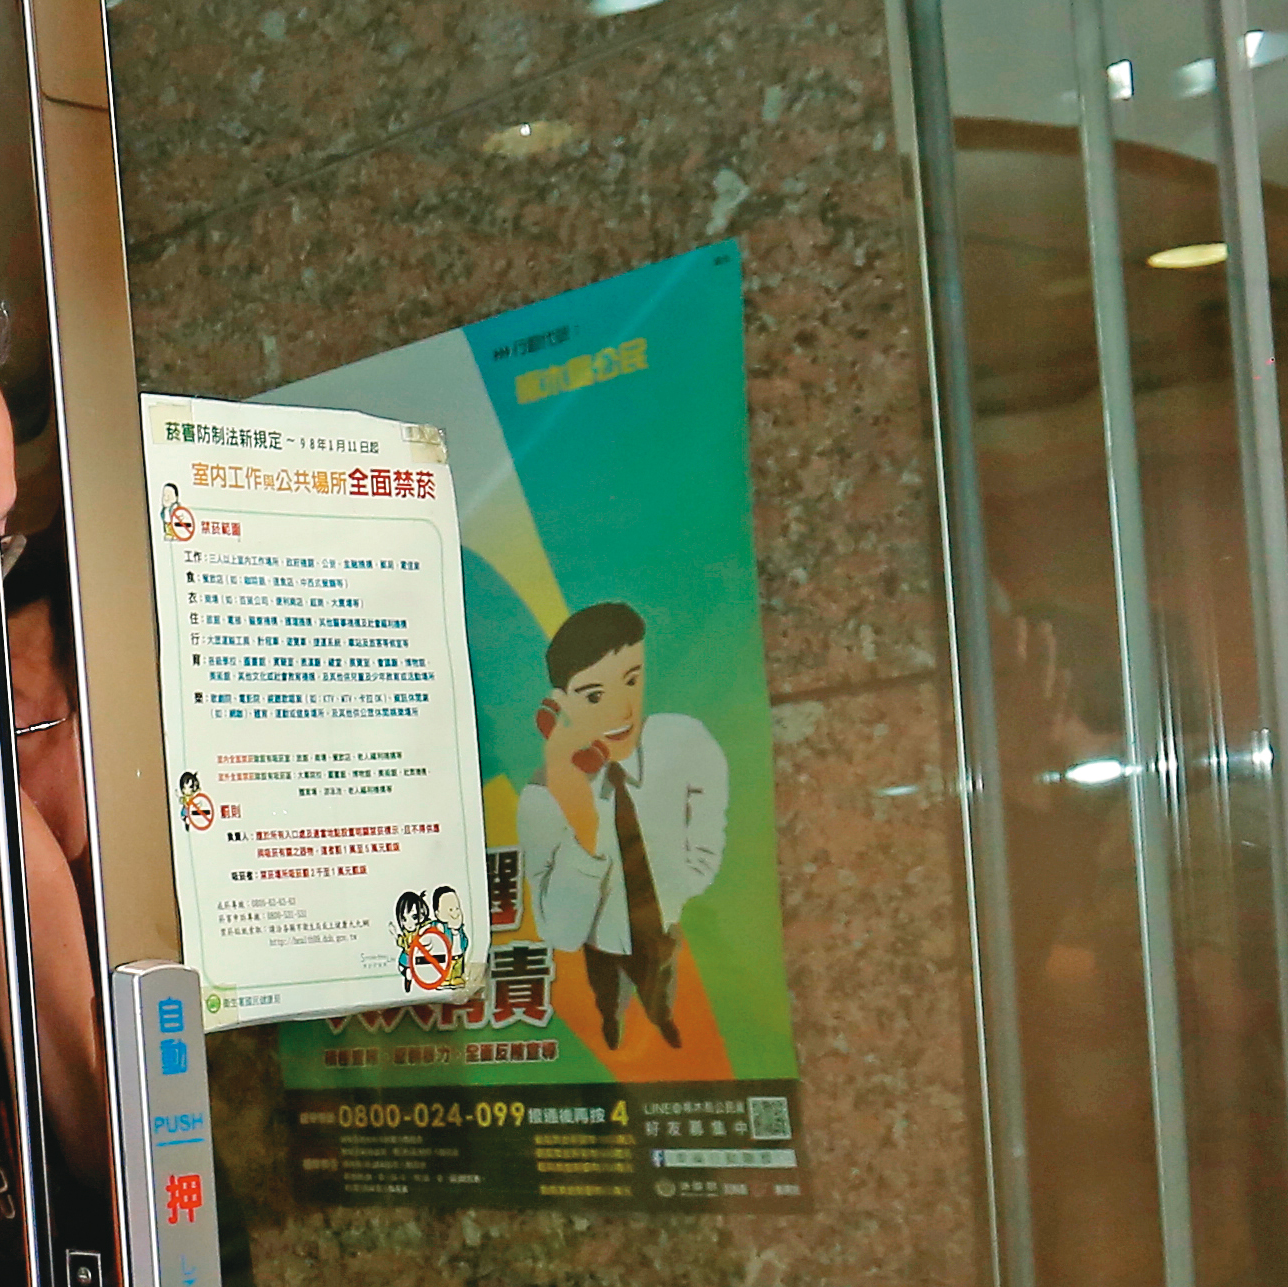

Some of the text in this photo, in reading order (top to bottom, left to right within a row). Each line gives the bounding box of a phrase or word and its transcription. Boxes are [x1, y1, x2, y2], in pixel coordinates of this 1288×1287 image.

[158, 996, 188, 1075] 自動
[153, 1113, 204, 1135] PUSH
[338, 1103, 525, 1128] 0800-024-099
[610, 1100, 629, 1126] 4
